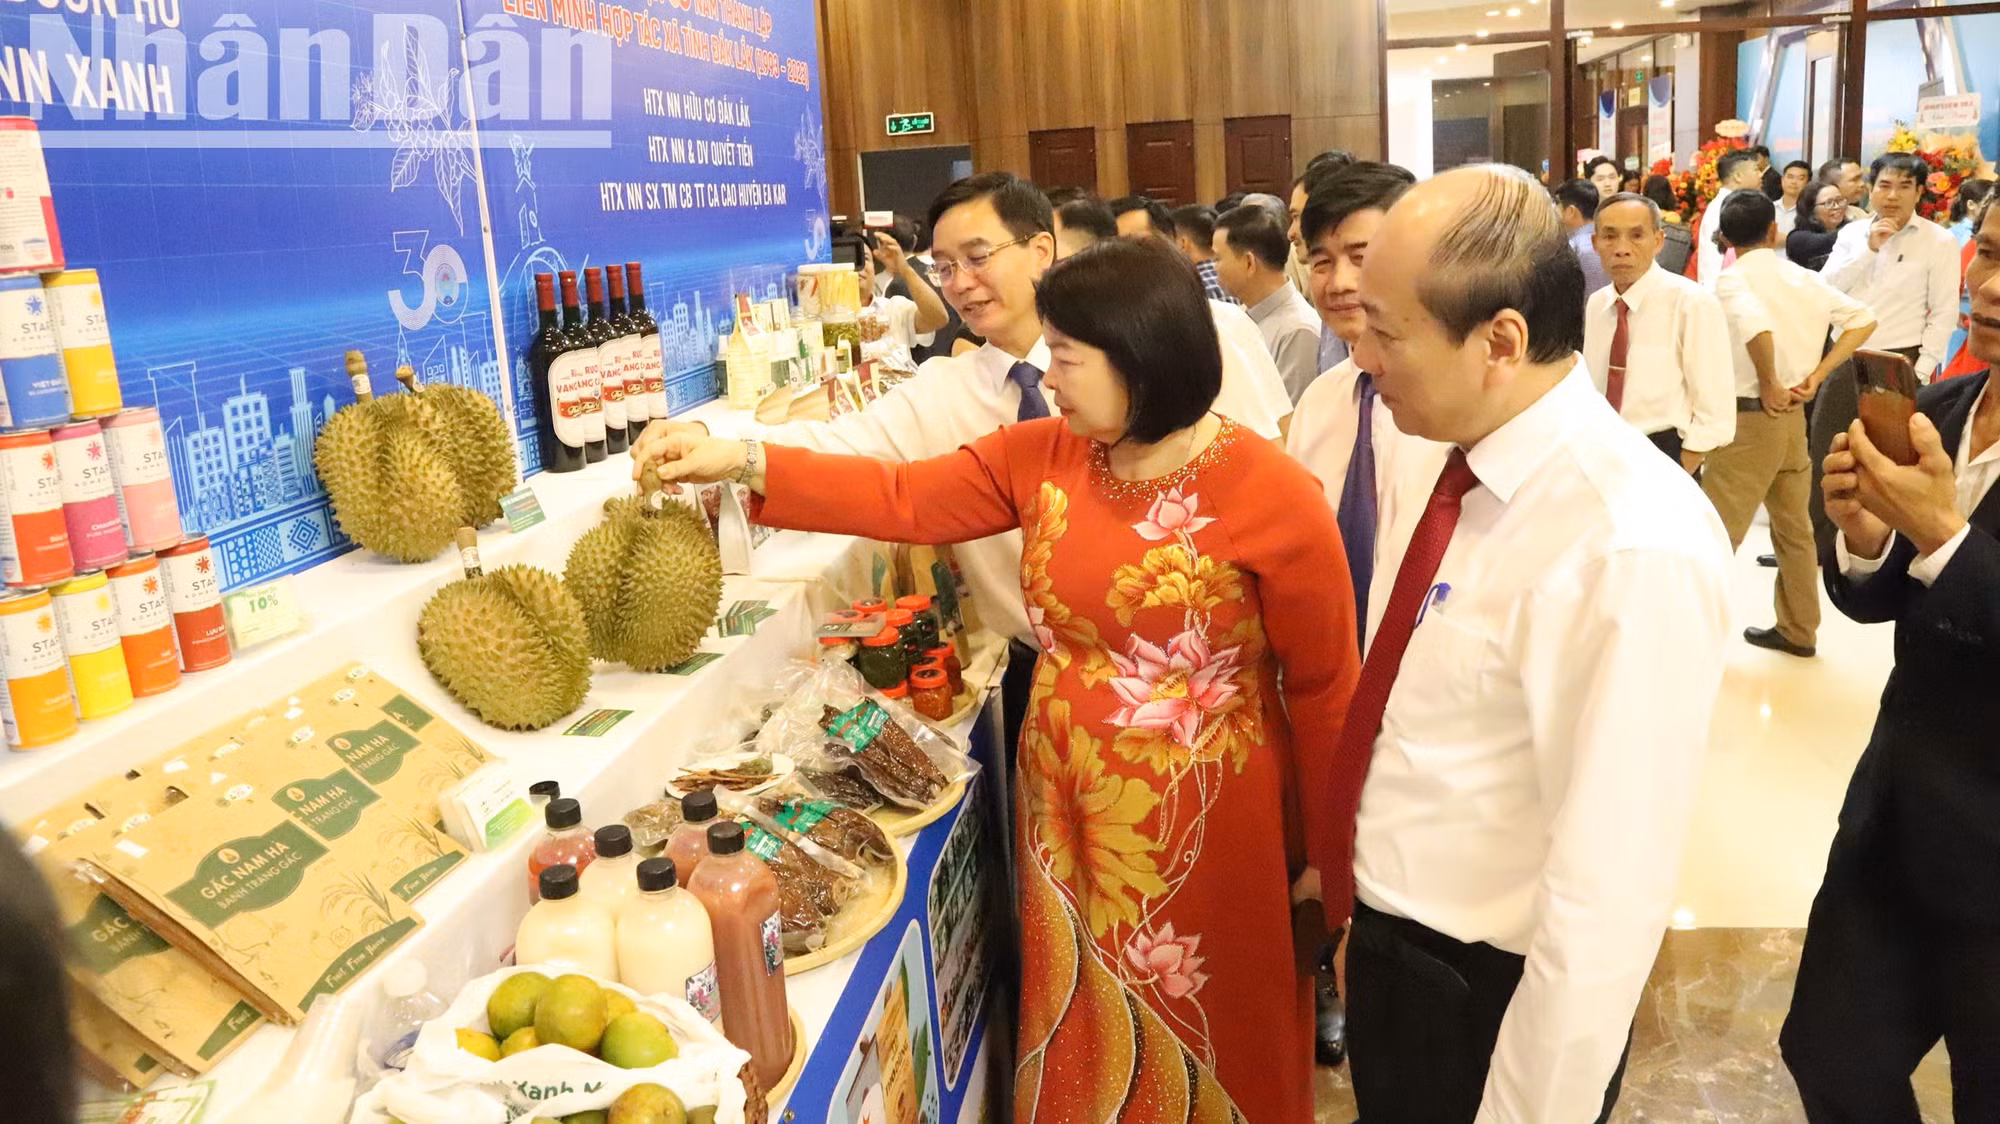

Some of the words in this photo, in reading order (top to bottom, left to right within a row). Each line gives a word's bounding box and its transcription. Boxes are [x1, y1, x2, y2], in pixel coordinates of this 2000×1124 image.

[551, 0, 597, 33] MINH
[600, 3, 633, 47] HỢP
[634, 9, 662, 49] TÁC
[755, 47, 780, 80] (1993
[65, 53, 174, 114] XANH
[644, 88, 665, 116] HTX
[666, 91, 681, 118] NN
[704, 96, 716, 123] CƠ
[648, 136, 669, 163] HTX
[671, 138, 685, 164] NN
[688, 140, 696, 164] &
[696, 140, 709, 165] DV
[711, 134, 736, 166] QUYẾT
[600, 182, 624, 211] HTX
[626, 182, 644, 210] NN
[645, 182, 660, 210] SX
[662, 183, 678, 209] TM
[679, 183, 692, 209] CB
[694, 184, 705, 208] TT
[707, 184, 720, 208] CA
[720, 184, 737, 207] CAO
[763, 184, 772, 206] EA
[772, 184, 787, 205] KAR
[250, 593, 278, 613] 10%
[346, 744, 374, 762] NAM
[298, 795, 330, 816] NAM
[230, 854, 269, 880] NAM
